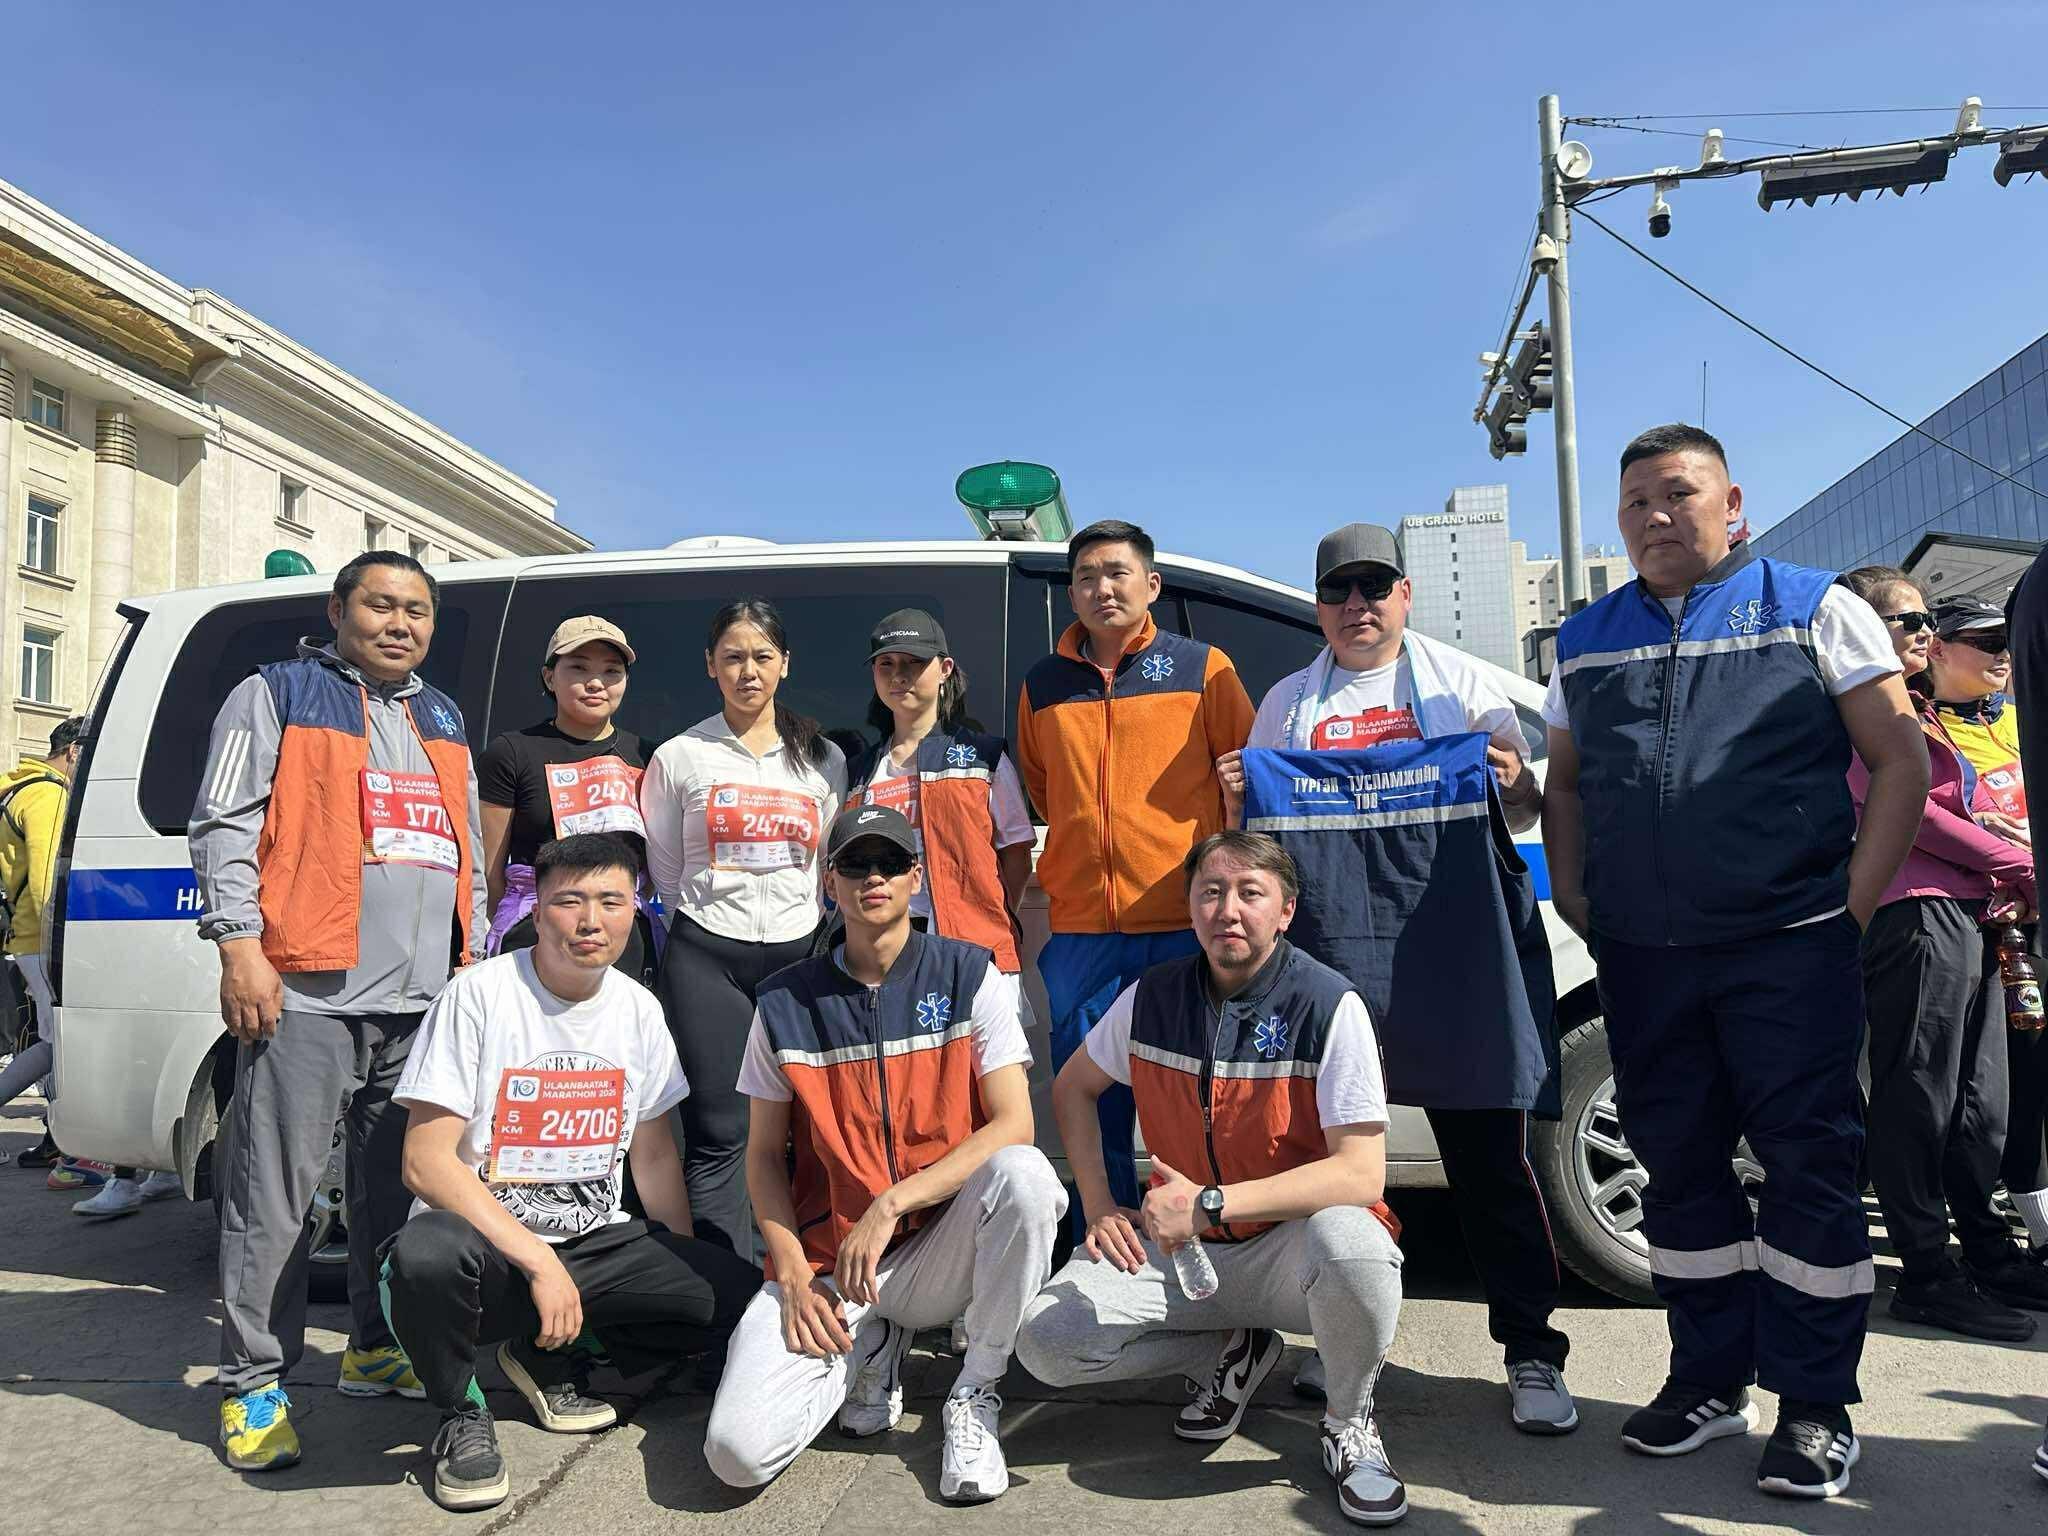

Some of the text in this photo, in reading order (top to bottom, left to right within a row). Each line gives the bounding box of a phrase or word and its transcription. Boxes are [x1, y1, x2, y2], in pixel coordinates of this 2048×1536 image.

[1407, 512, 1505, 527] UB GRAND HOTEL
[1356, 724, 1408, 736] MARATHON
[1347, 764, 1440, 792] ТУСЛАМЖИЙН
[559, 792, 570, 802] 5
[375, 798, 386, 809] 5
[556, 801, 576, 811] KM
[2003, 803, 2020, 813] KM
[372, 810, 391, 818] KM
[716, 814, 726, 825] 5
[543, 1081, 609, 1090] ULAANBAATAR
[542, 1090, 597, 1099] MARATHON
[508, 1110, 521, 1123] 5
[540, 1107, 618, 1141] 24706
[501, 1125, 523, 1134] KM
